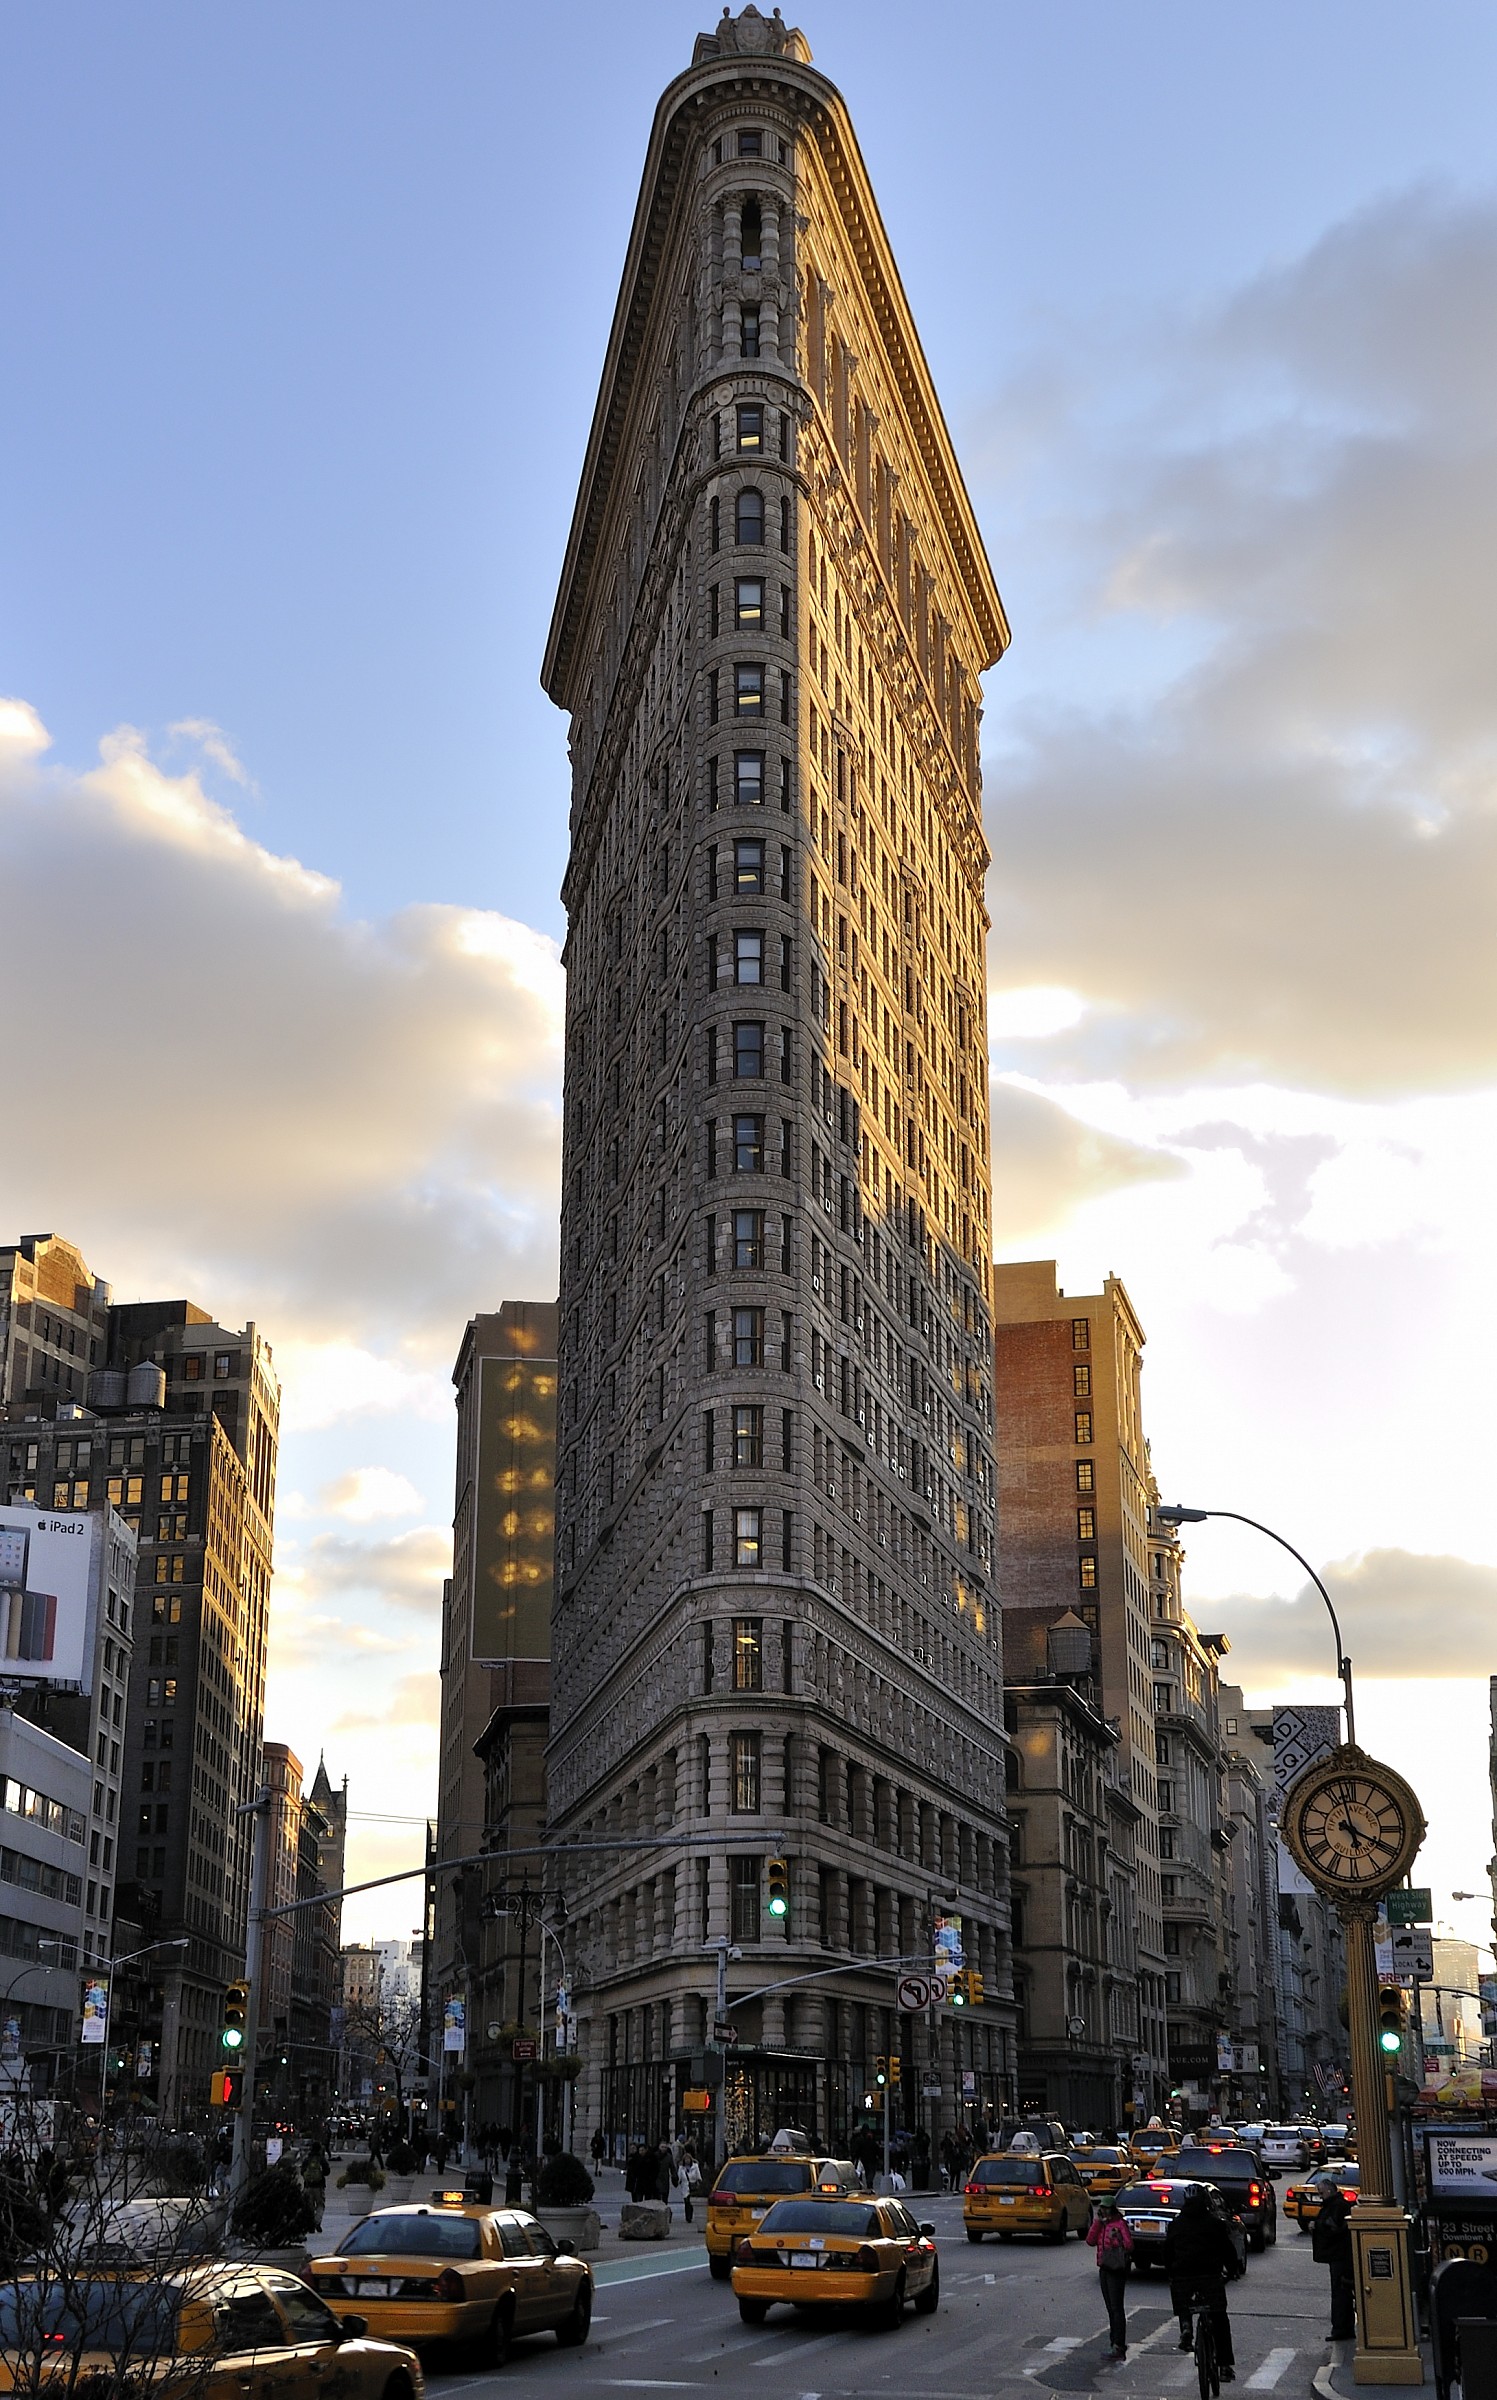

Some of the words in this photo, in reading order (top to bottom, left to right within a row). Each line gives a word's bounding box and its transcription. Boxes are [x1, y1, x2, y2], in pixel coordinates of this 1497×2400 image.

[50, 1520, 76, 1534] iPad
[77, 1523, 84, 1535] 2
[1274, 1753, 1304, 1779] SQ.
[1327, 1808, 1345, 1832] FIFTH
[1348, 1805, 1378, 1829] AVENUE
[1333, 1841, 1375, 1857] BUILDING
[1389, 1891, 1409, 1901] West
[1411, 1890, 1429, 1900] Side
[1392, 1900, 1427, 1911] Highway
[1394, 1960, 1414, 1969] LOCAL
[1378, 1972, 1406, 1983] GREY
[1436, 2140, 1457, 2148] NOW
[1437, 2147, 1492, 2155] CONNECTING
[1438, 2160, 1450, 2168] UP
[1438, 2167, 1454, 2175] 600
[1455, 2167, 1477, 2176] MPH.
[1442, 2222, 1457, 2233] 23
[1461, 2221, 1495, 2234] Street
[1442, 2233, 1484, 2242] Downtown
[1486, 2233, 1493, 2242] &
[1449, 2247, 1460, 2258] N
[1473, 2248, 1484, 2261] R
